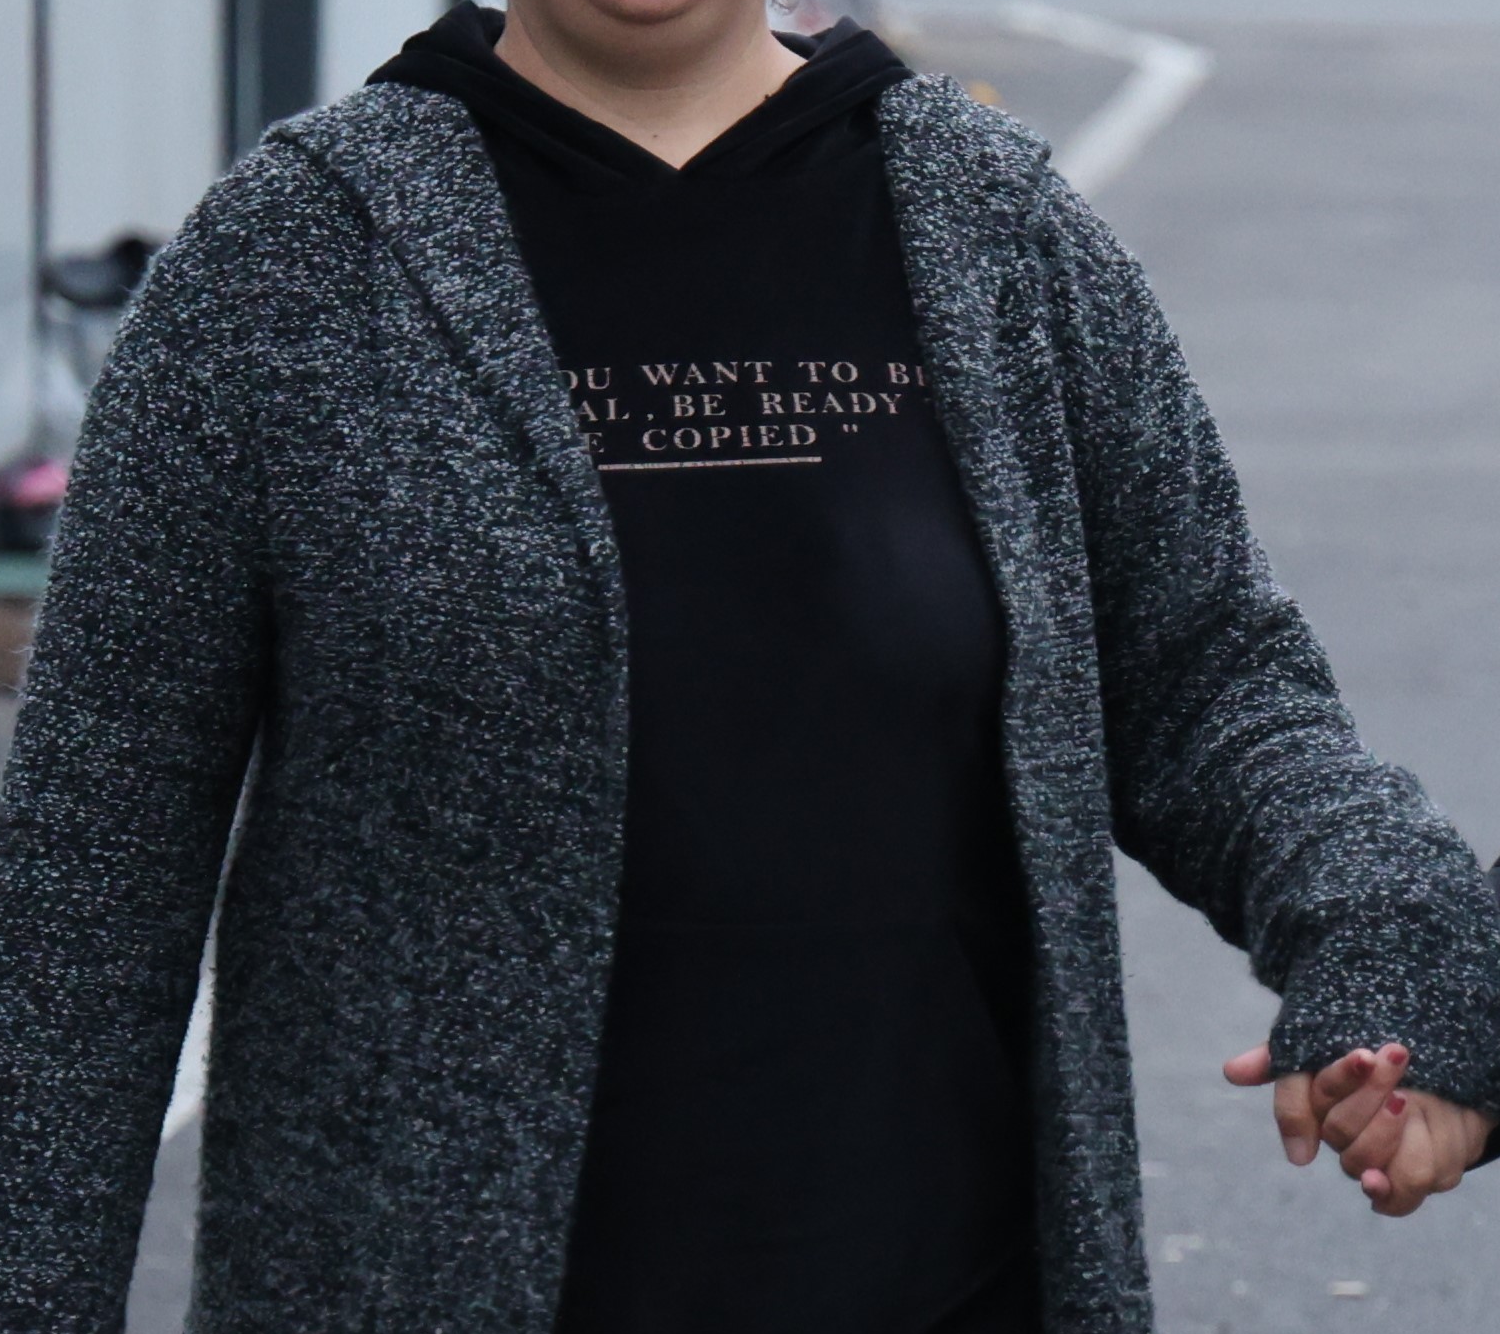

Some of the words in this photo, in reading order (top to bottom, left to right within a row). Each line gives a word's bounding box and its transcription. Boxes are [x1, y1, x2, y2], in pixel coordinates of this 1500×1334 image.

[558, 367, 611, 390] OU
[639, 361, 773, 386] WANT
[798, 361, 859, 383] TO
[673, 394, 727, 417] BE
[760, 392, 902, 415] READY
[642, 424, 817, 451] COPIED
